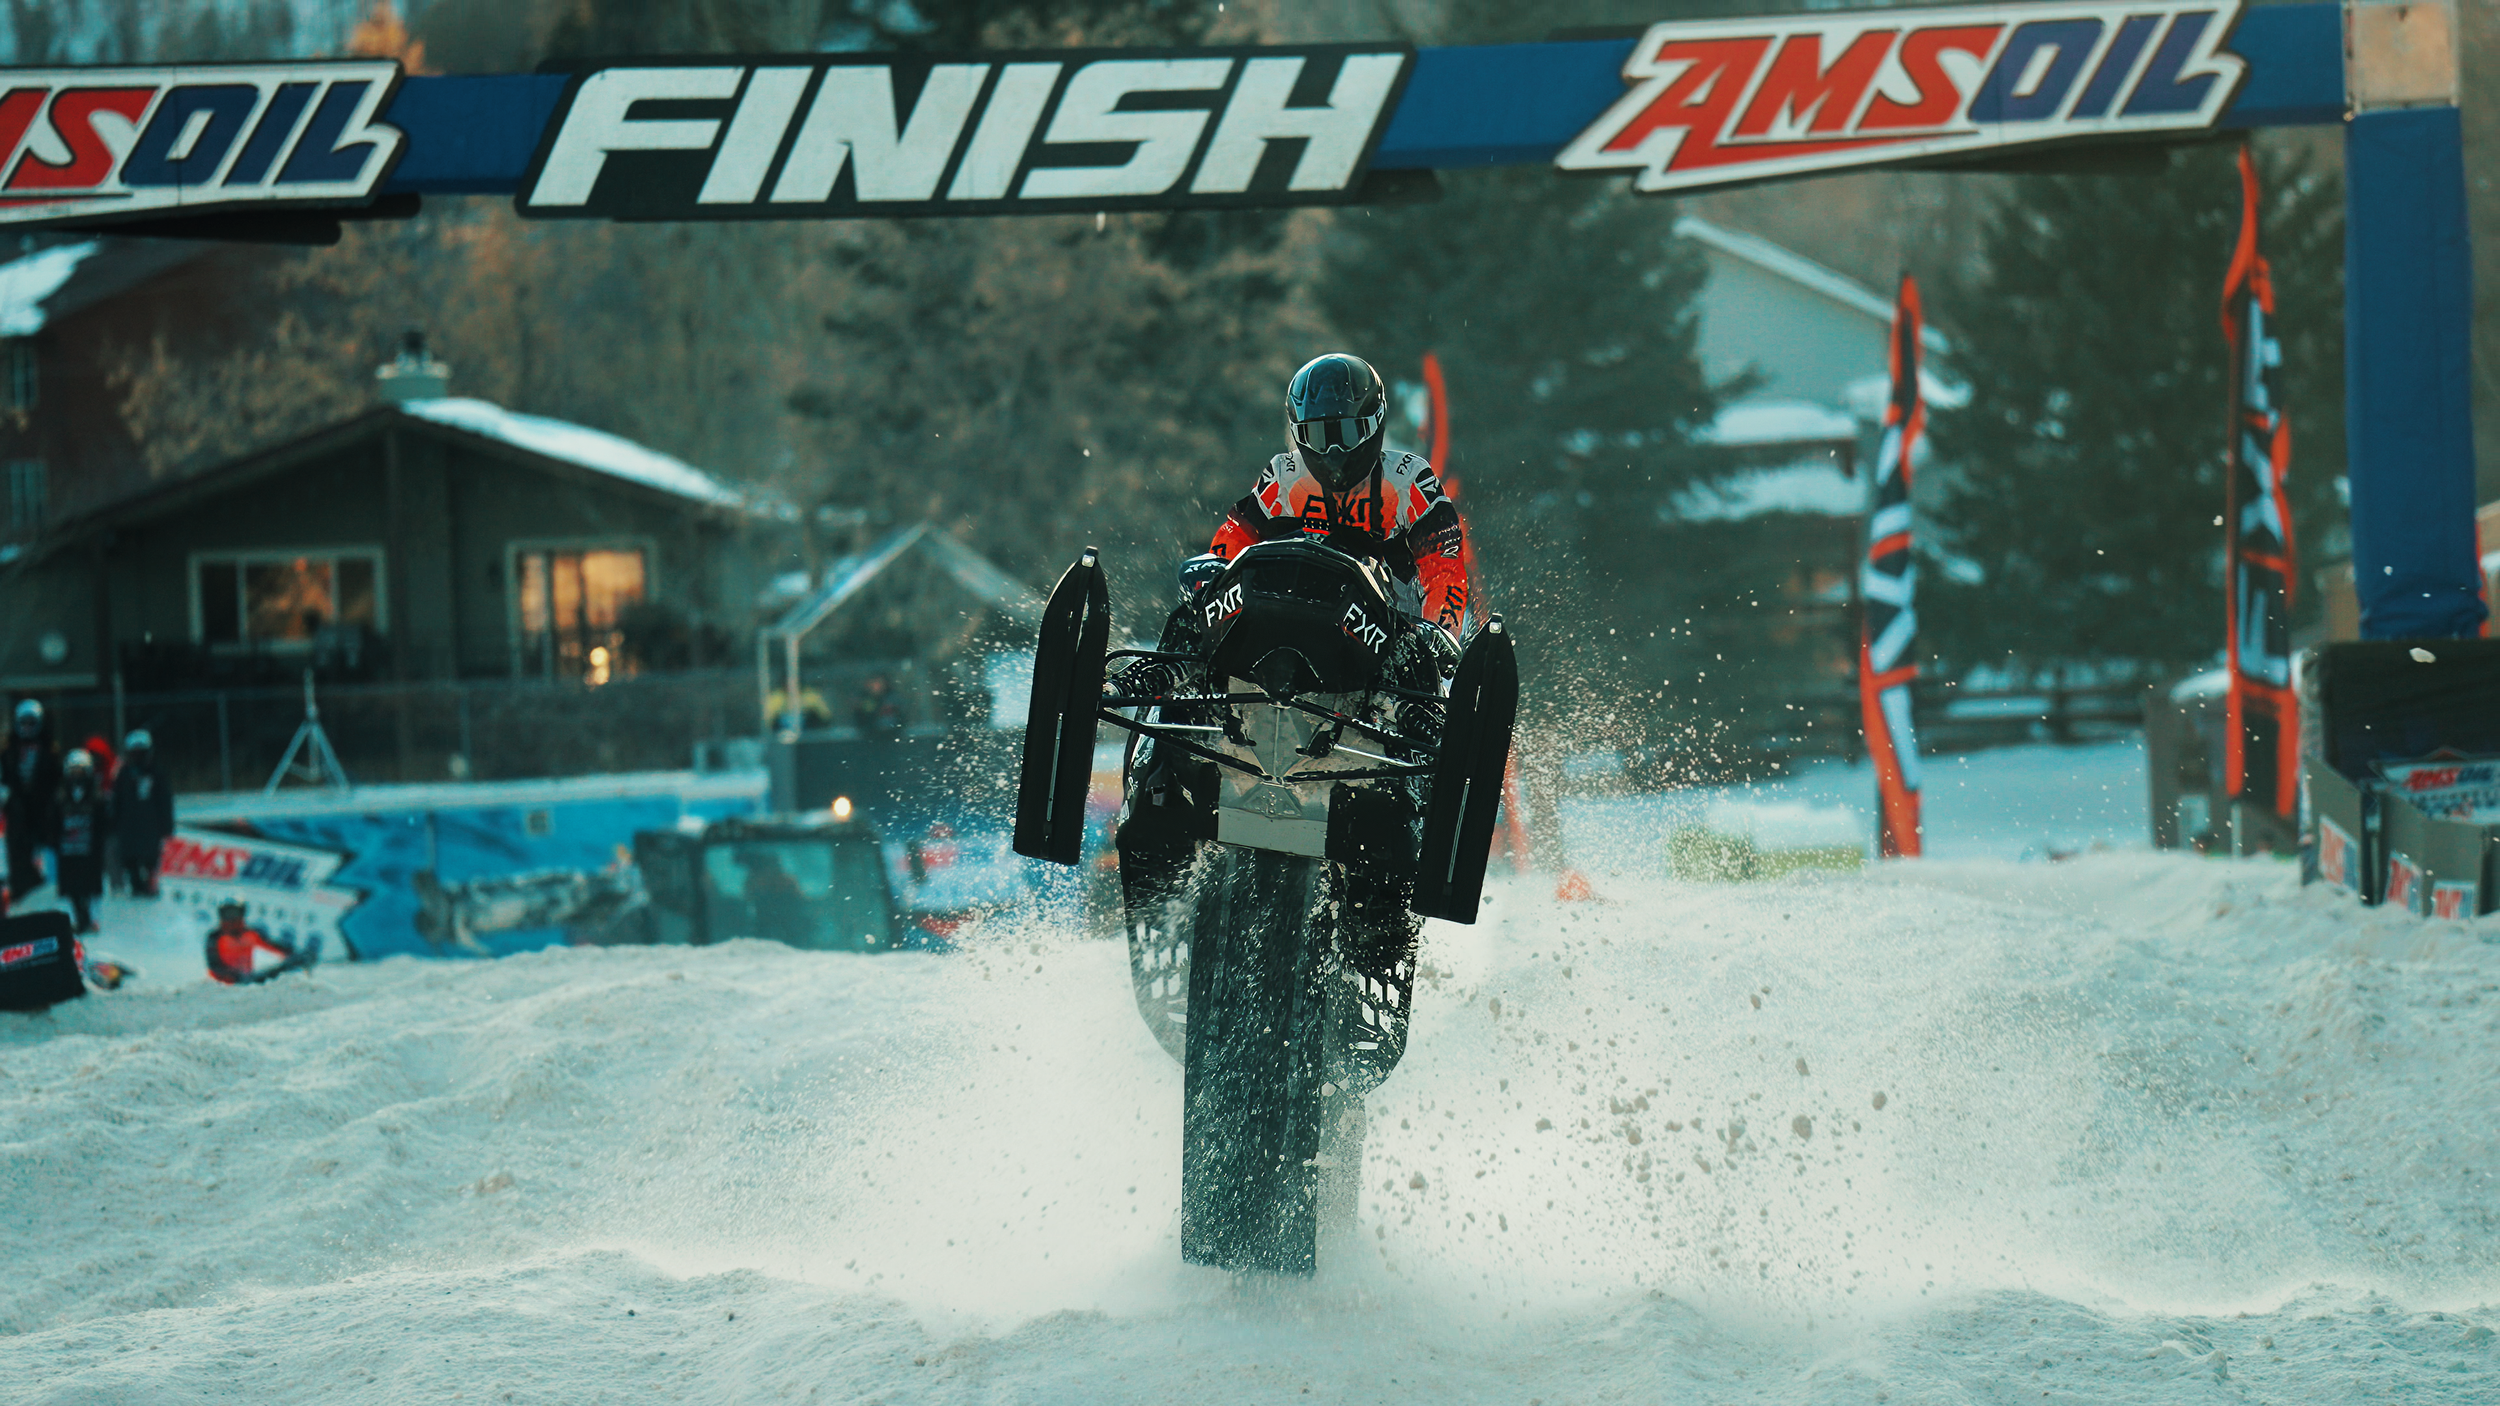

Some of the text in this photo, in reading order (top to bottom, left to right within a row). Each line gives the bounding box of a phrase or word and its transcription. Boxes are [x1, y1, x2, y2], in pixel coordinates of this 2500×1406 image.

[528, 53, 1406, 207] FINISH
[1600, 14, 2210, 173] AMSOIL
[1205, 583, 1243, 627] FXR
[1343, 603, 1388, 654] FXR
